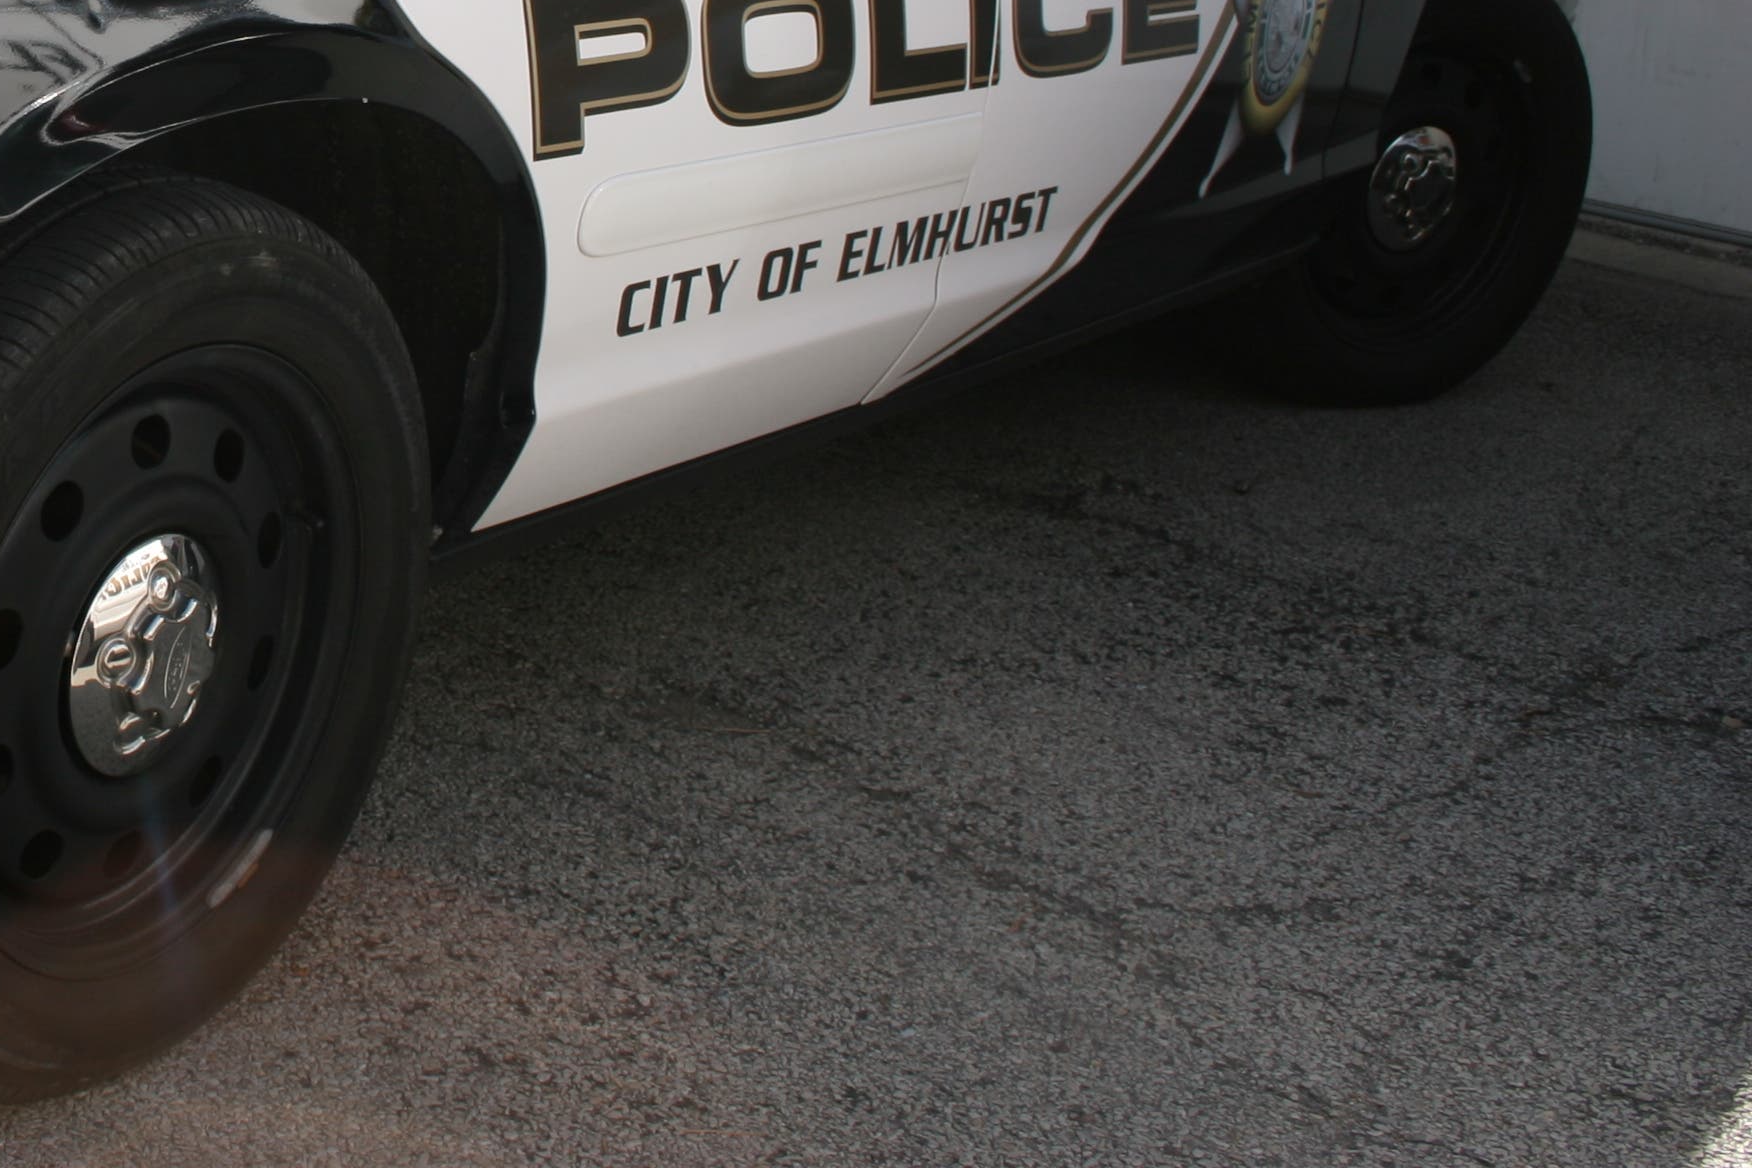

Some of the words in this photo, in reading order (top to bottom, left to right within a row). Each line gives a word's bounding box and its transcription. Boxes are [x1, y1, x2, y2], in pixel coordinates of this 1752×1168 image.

[616, 257, 739, 338] CITY
[756, 240, 823, 302] OF
[836, 186, 1058, 283] ELMHURST
